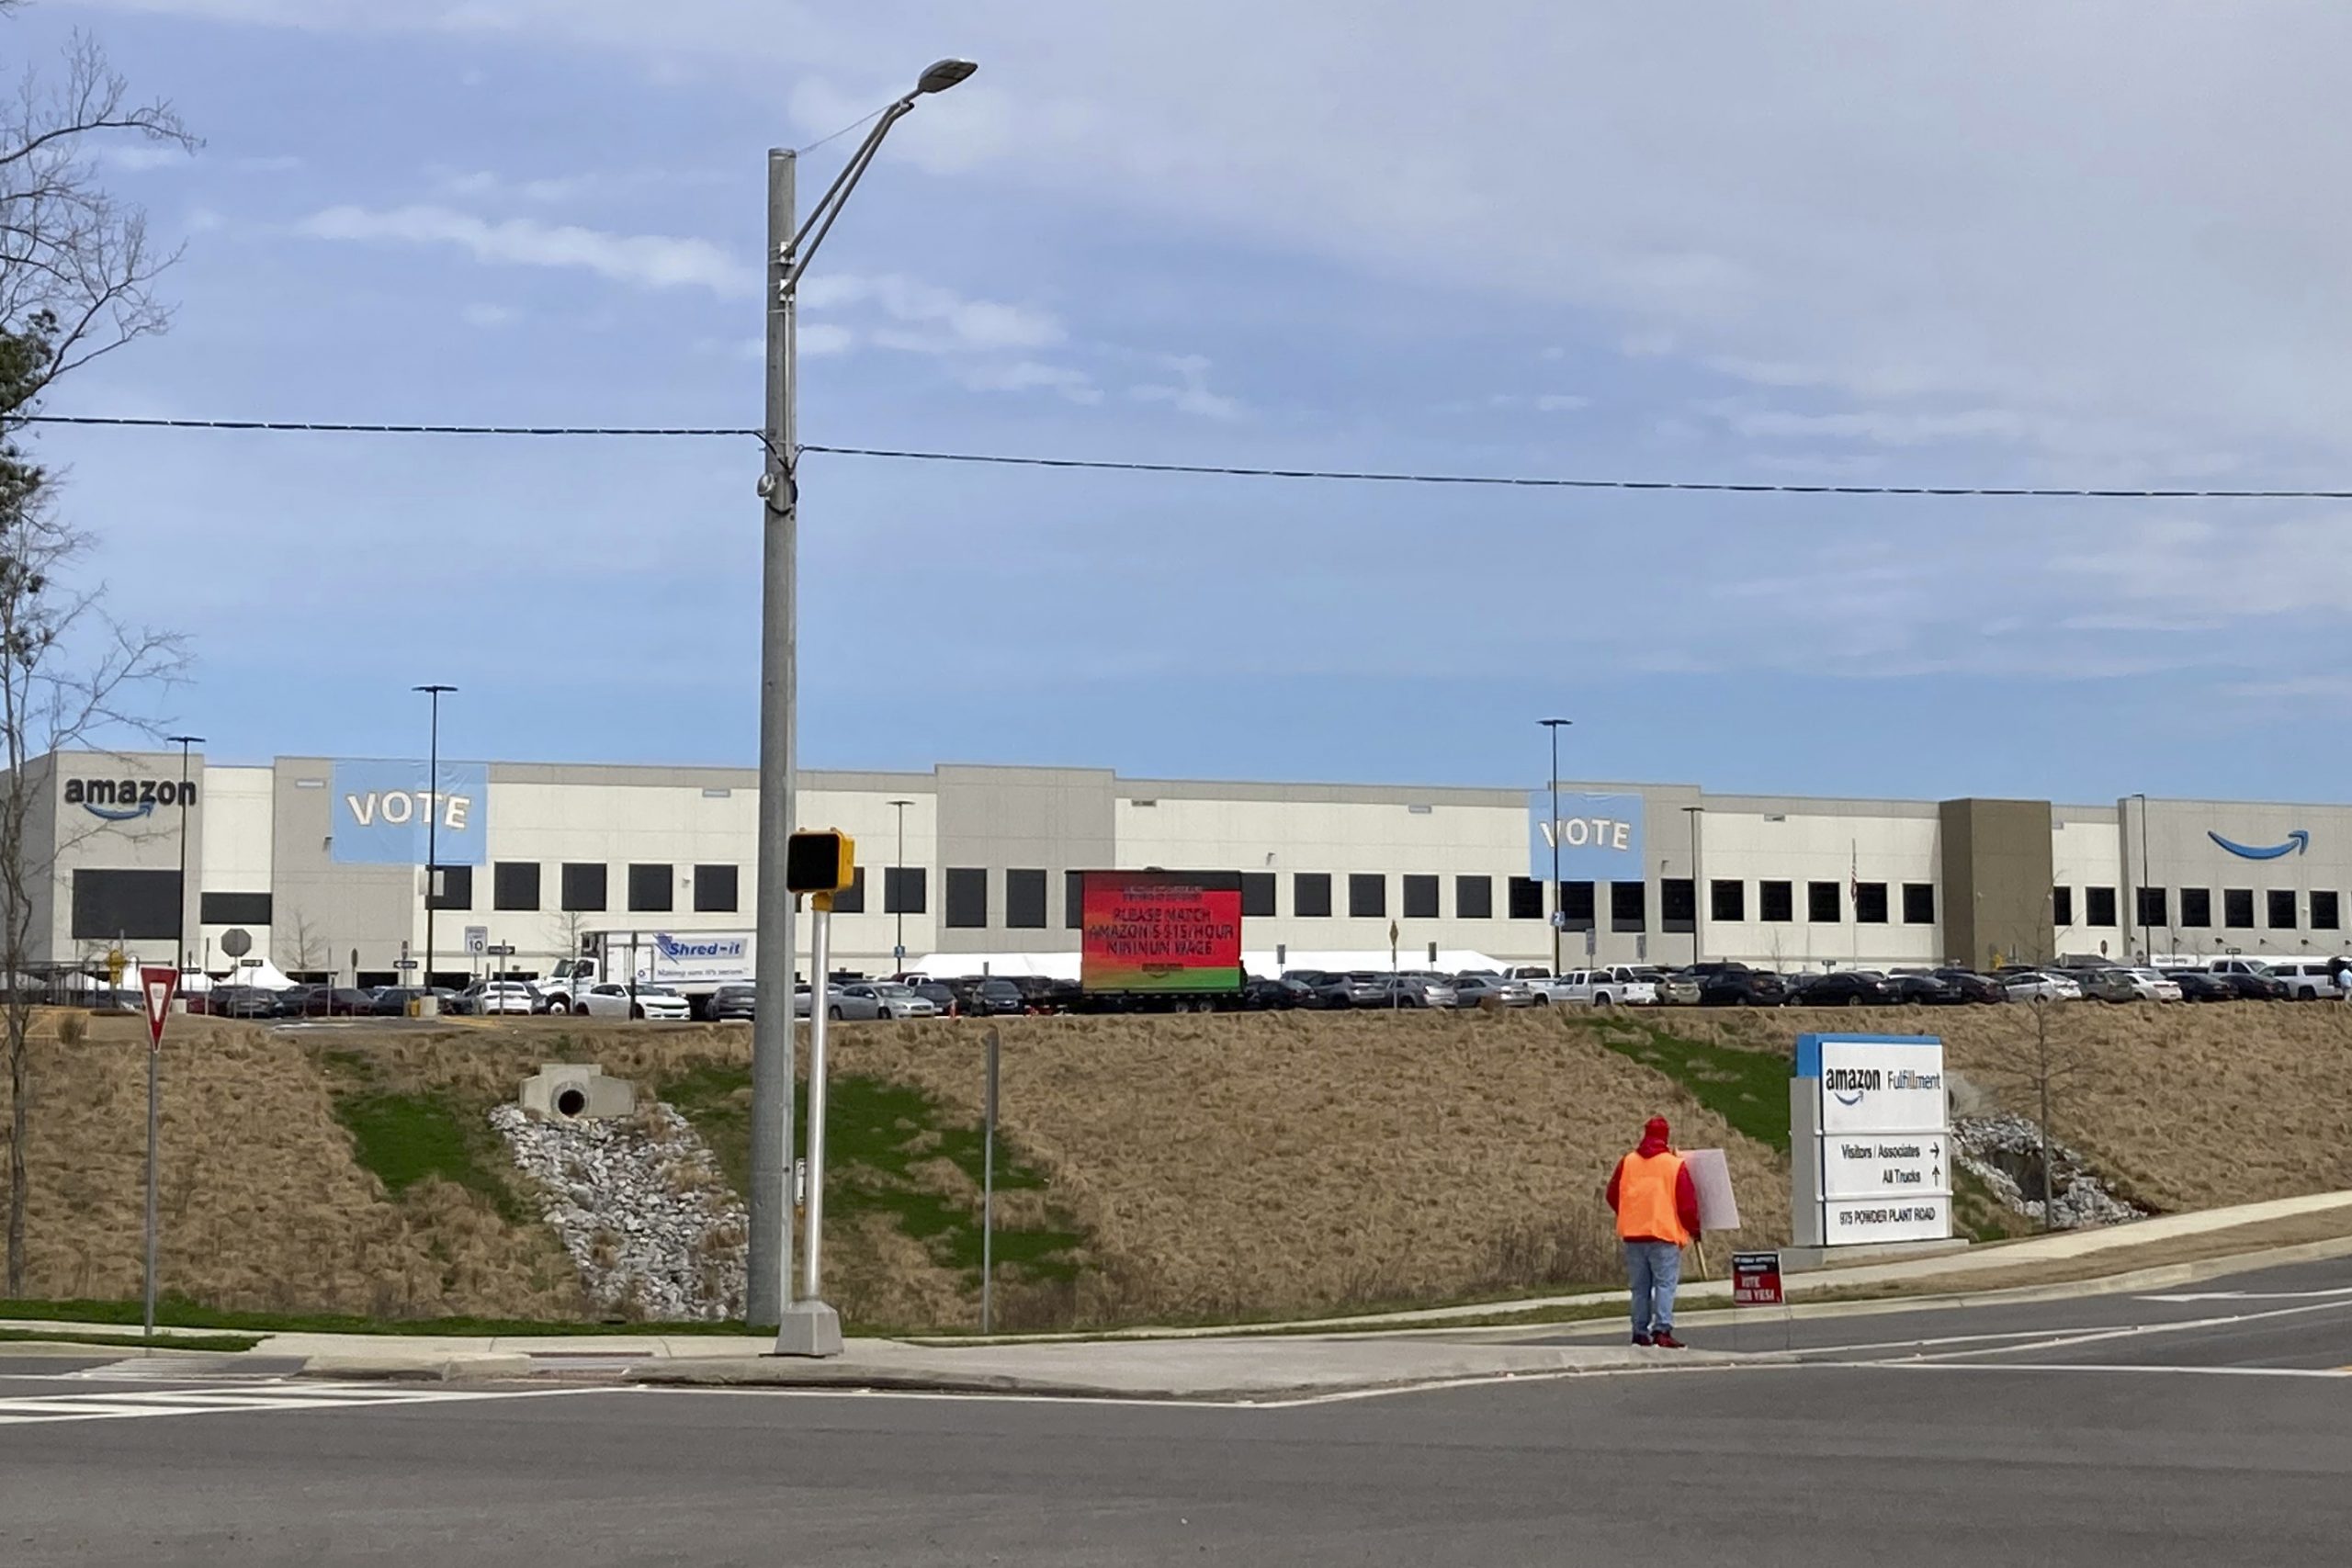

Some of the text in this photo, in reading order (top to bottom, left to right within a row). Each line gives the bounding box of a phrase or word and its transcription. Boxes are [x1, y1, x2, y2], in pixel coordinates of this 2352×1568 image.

[64, 778, 197, 806] amazon
[346, 789, 471, 829] VOTE
[1539, 817, 1631, 851] VOTE
[1113, 907, 1211, 922] PLEASE MATCH
[469, 940, 483, 952] 10
[668, 942, 741, 955] Shred-it
[1175, 941, 1213, 955] WAGE
[1826, 1068, 1940, 1091] amazon Fulfillment
[1841, 1144, 1872, 1158] Visitors
[1878, 1144, 1920, 1157] Associates
[1883, 1168, 1921, 1183] All Trucks
[1854, 1209, 1887, 1224] POWDER
[1889, 1208, 1912, 1222] PLANT
[1914, 1207, 1935, 1221] ROAD
